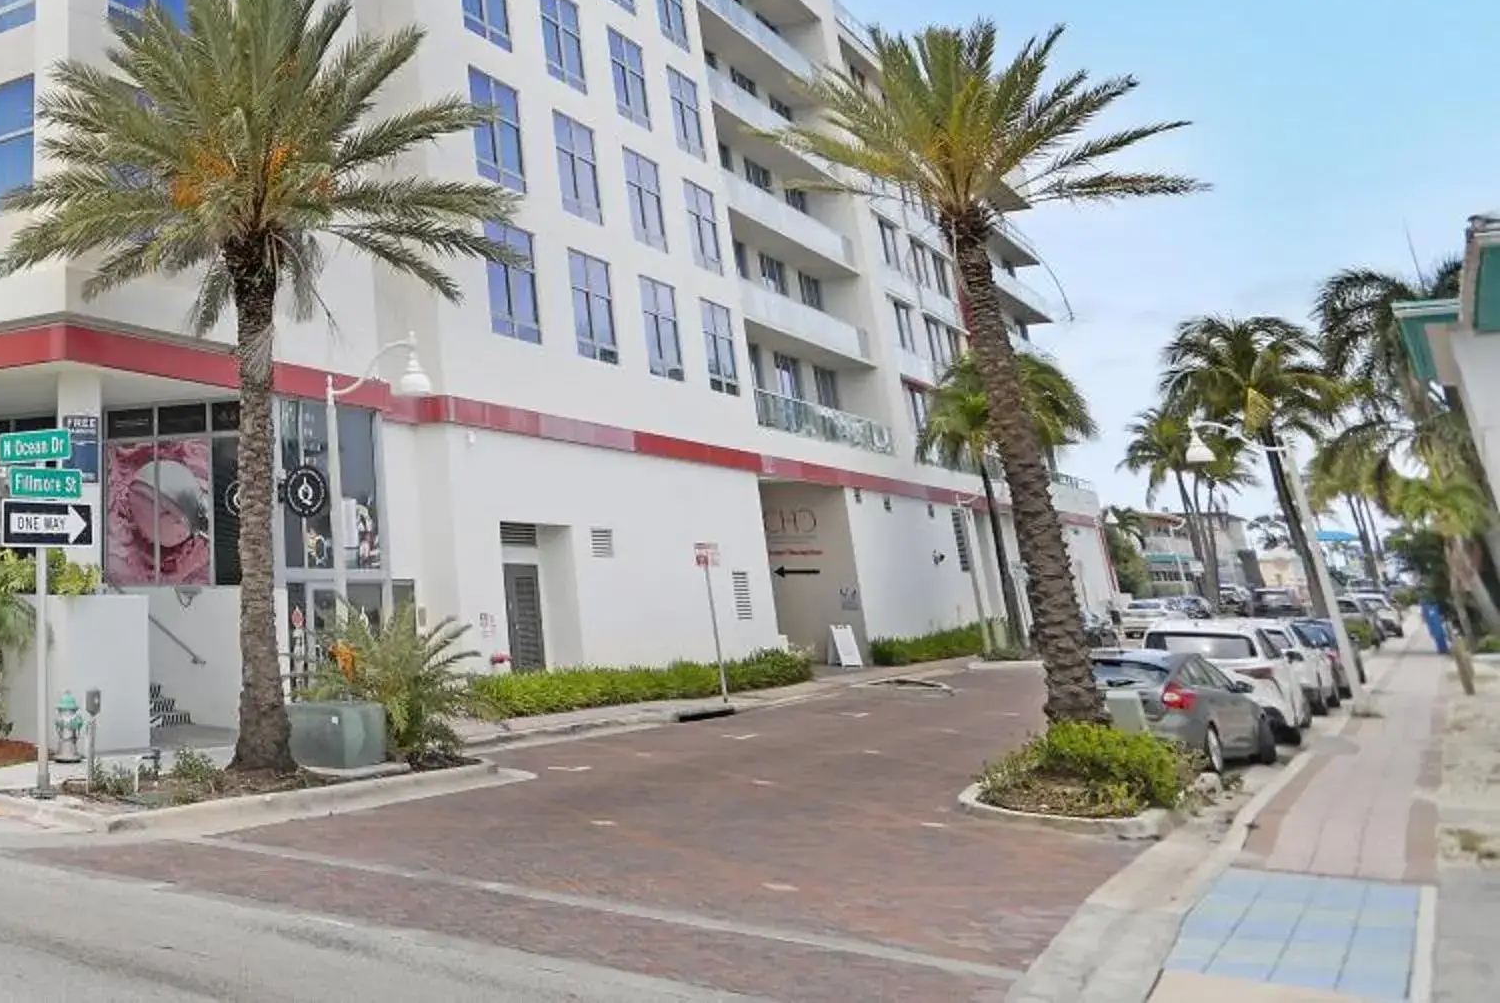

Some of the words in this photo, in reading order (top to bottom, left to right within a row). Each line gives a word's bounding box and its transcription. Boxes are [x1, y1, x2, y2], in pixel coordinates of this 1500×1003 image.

[3, 440, 12, 457] N
[14, 439, 49, 455] Ocean
[51, 436, 65, 454] Dr
[14, 473, 61, 493] Fillmore
[64, 476, 77, 493] St
[297, 476, 313, 506] Q
[17, 515, 40, 530] ONE
[44, 517, 67, 531] WAY
